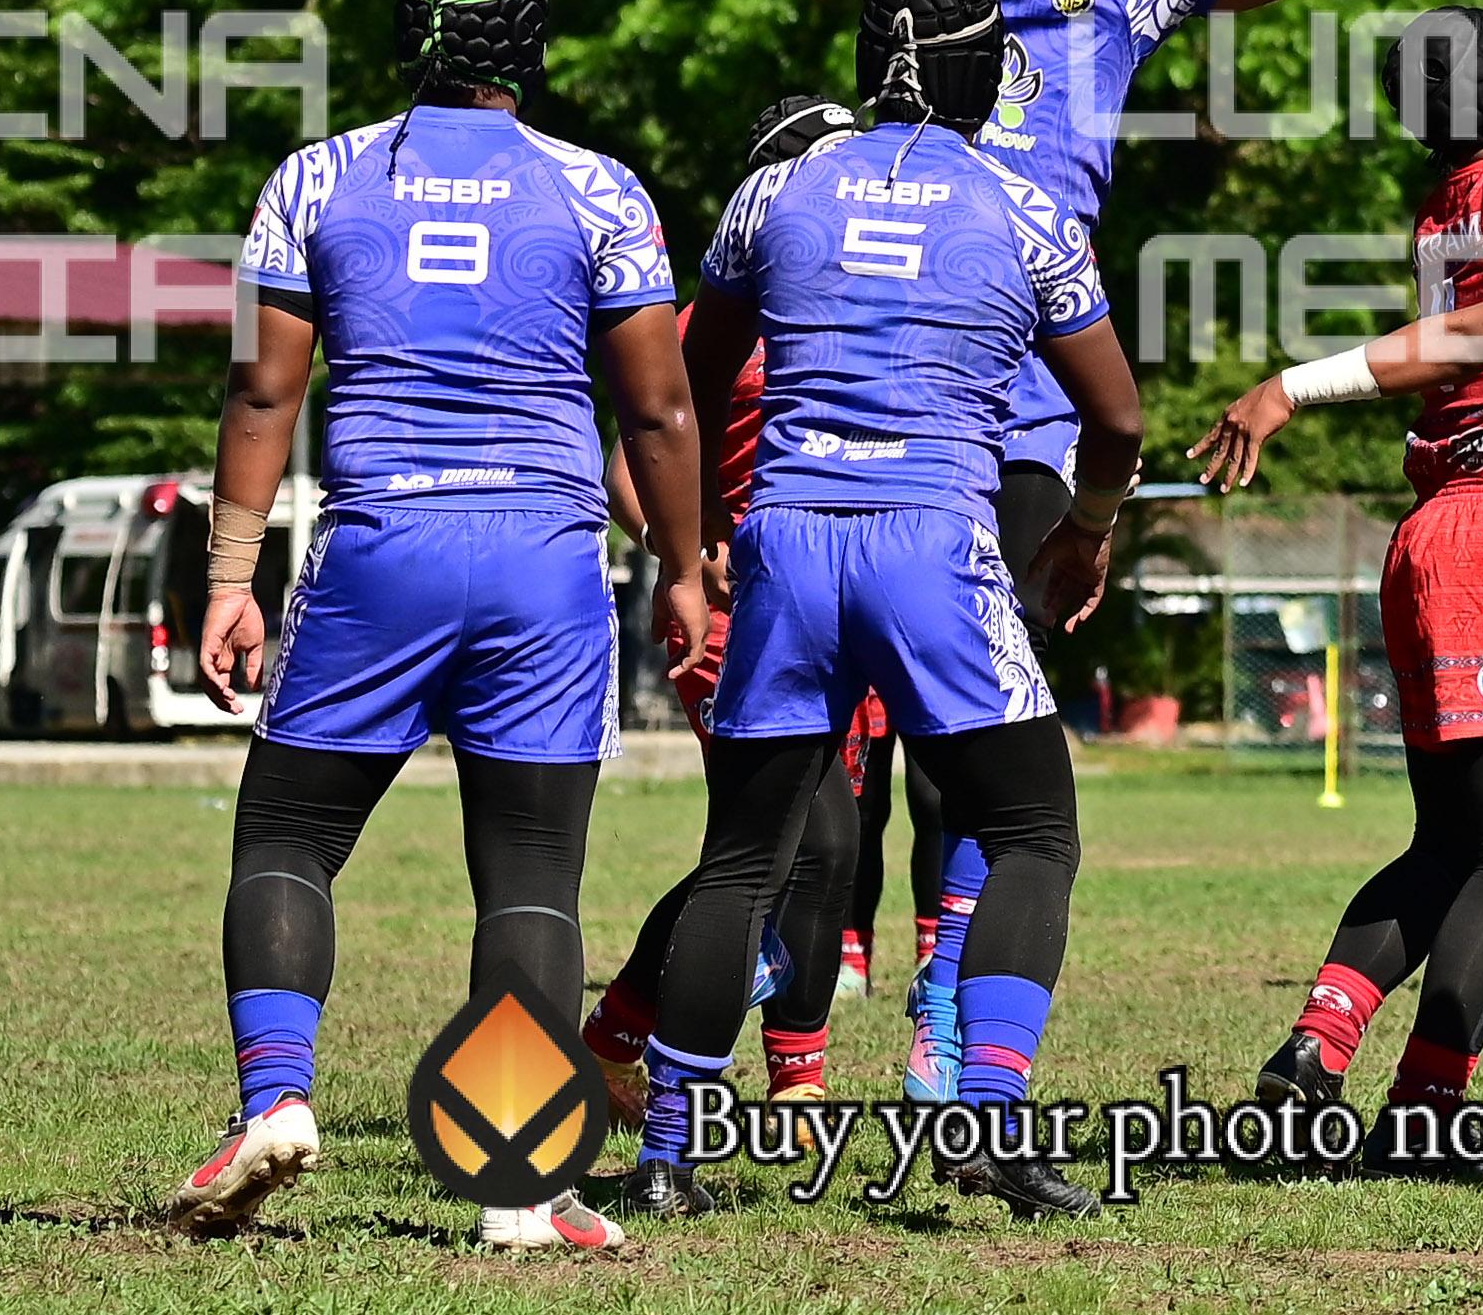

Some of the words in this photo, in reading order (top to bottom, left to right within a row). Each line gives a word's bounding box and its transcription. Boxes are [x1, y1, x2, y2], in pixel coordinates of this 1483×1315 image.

[393, 175, 511, 205] HSBP
[835, 176, 951, 207] HSBP
[406, 220, 491, 285] 8
[840, 218, 927, 280] 5
[770, 1052, 825, 1067] AKR
